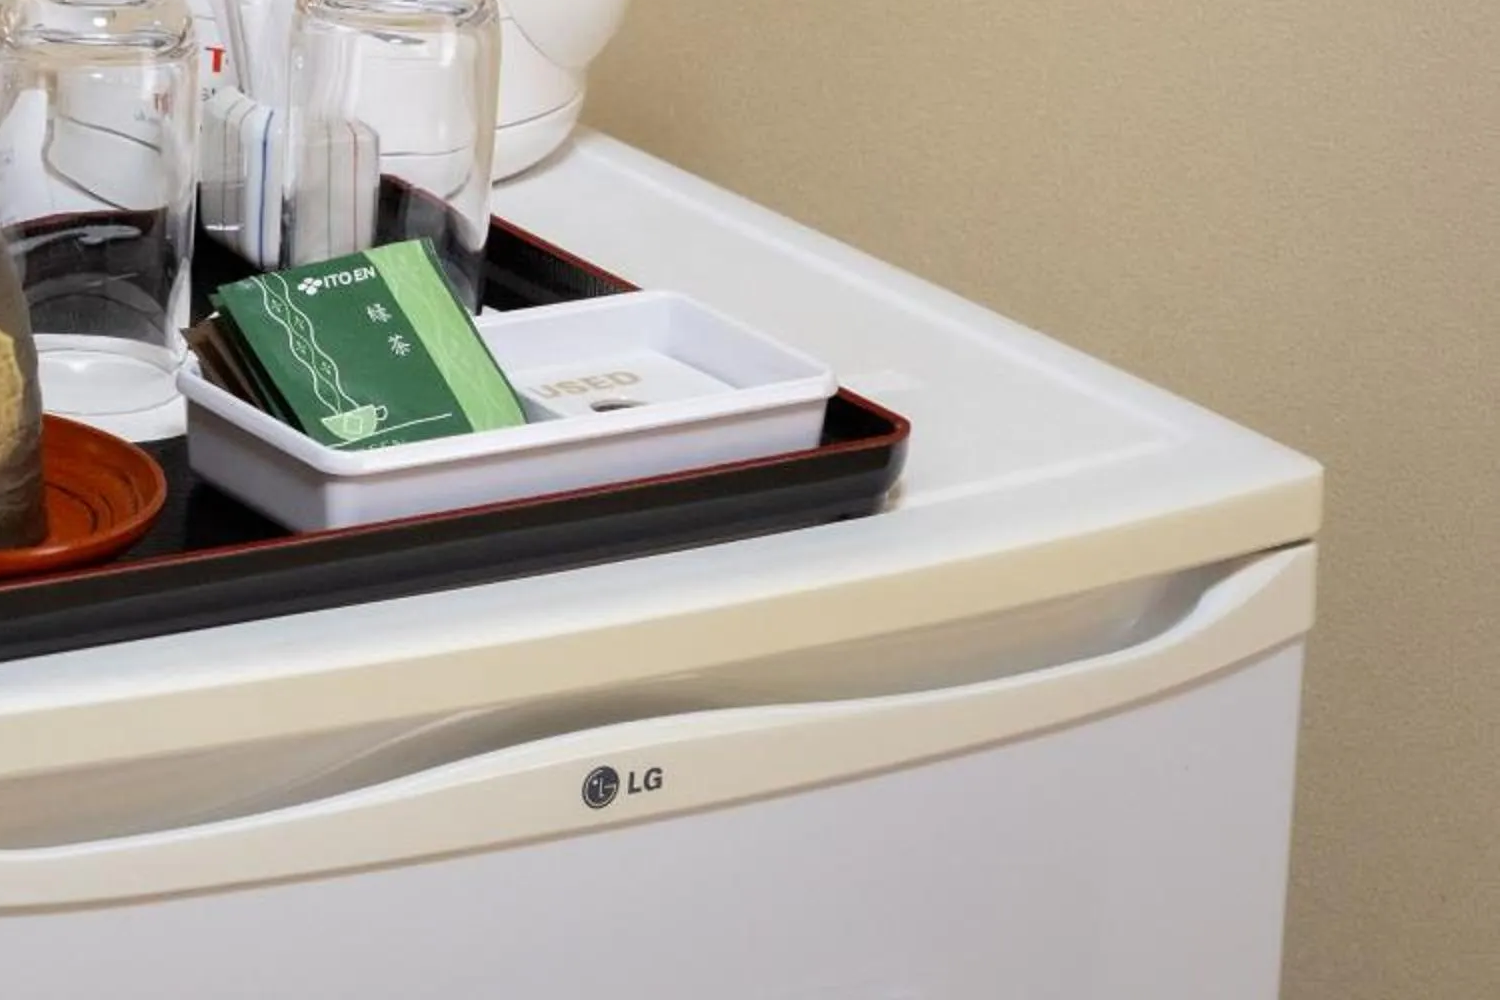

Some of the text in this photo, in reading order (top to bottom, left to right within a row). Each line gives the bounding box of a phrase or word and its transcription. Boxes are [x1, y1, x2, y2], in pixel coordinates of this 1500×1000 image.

[323, 266, 376, 289] ITO EN
[367, 302, 411, 357] 緑茶
[529, 371, 643, 400] USED
[628, 767, 663, 794] LG
